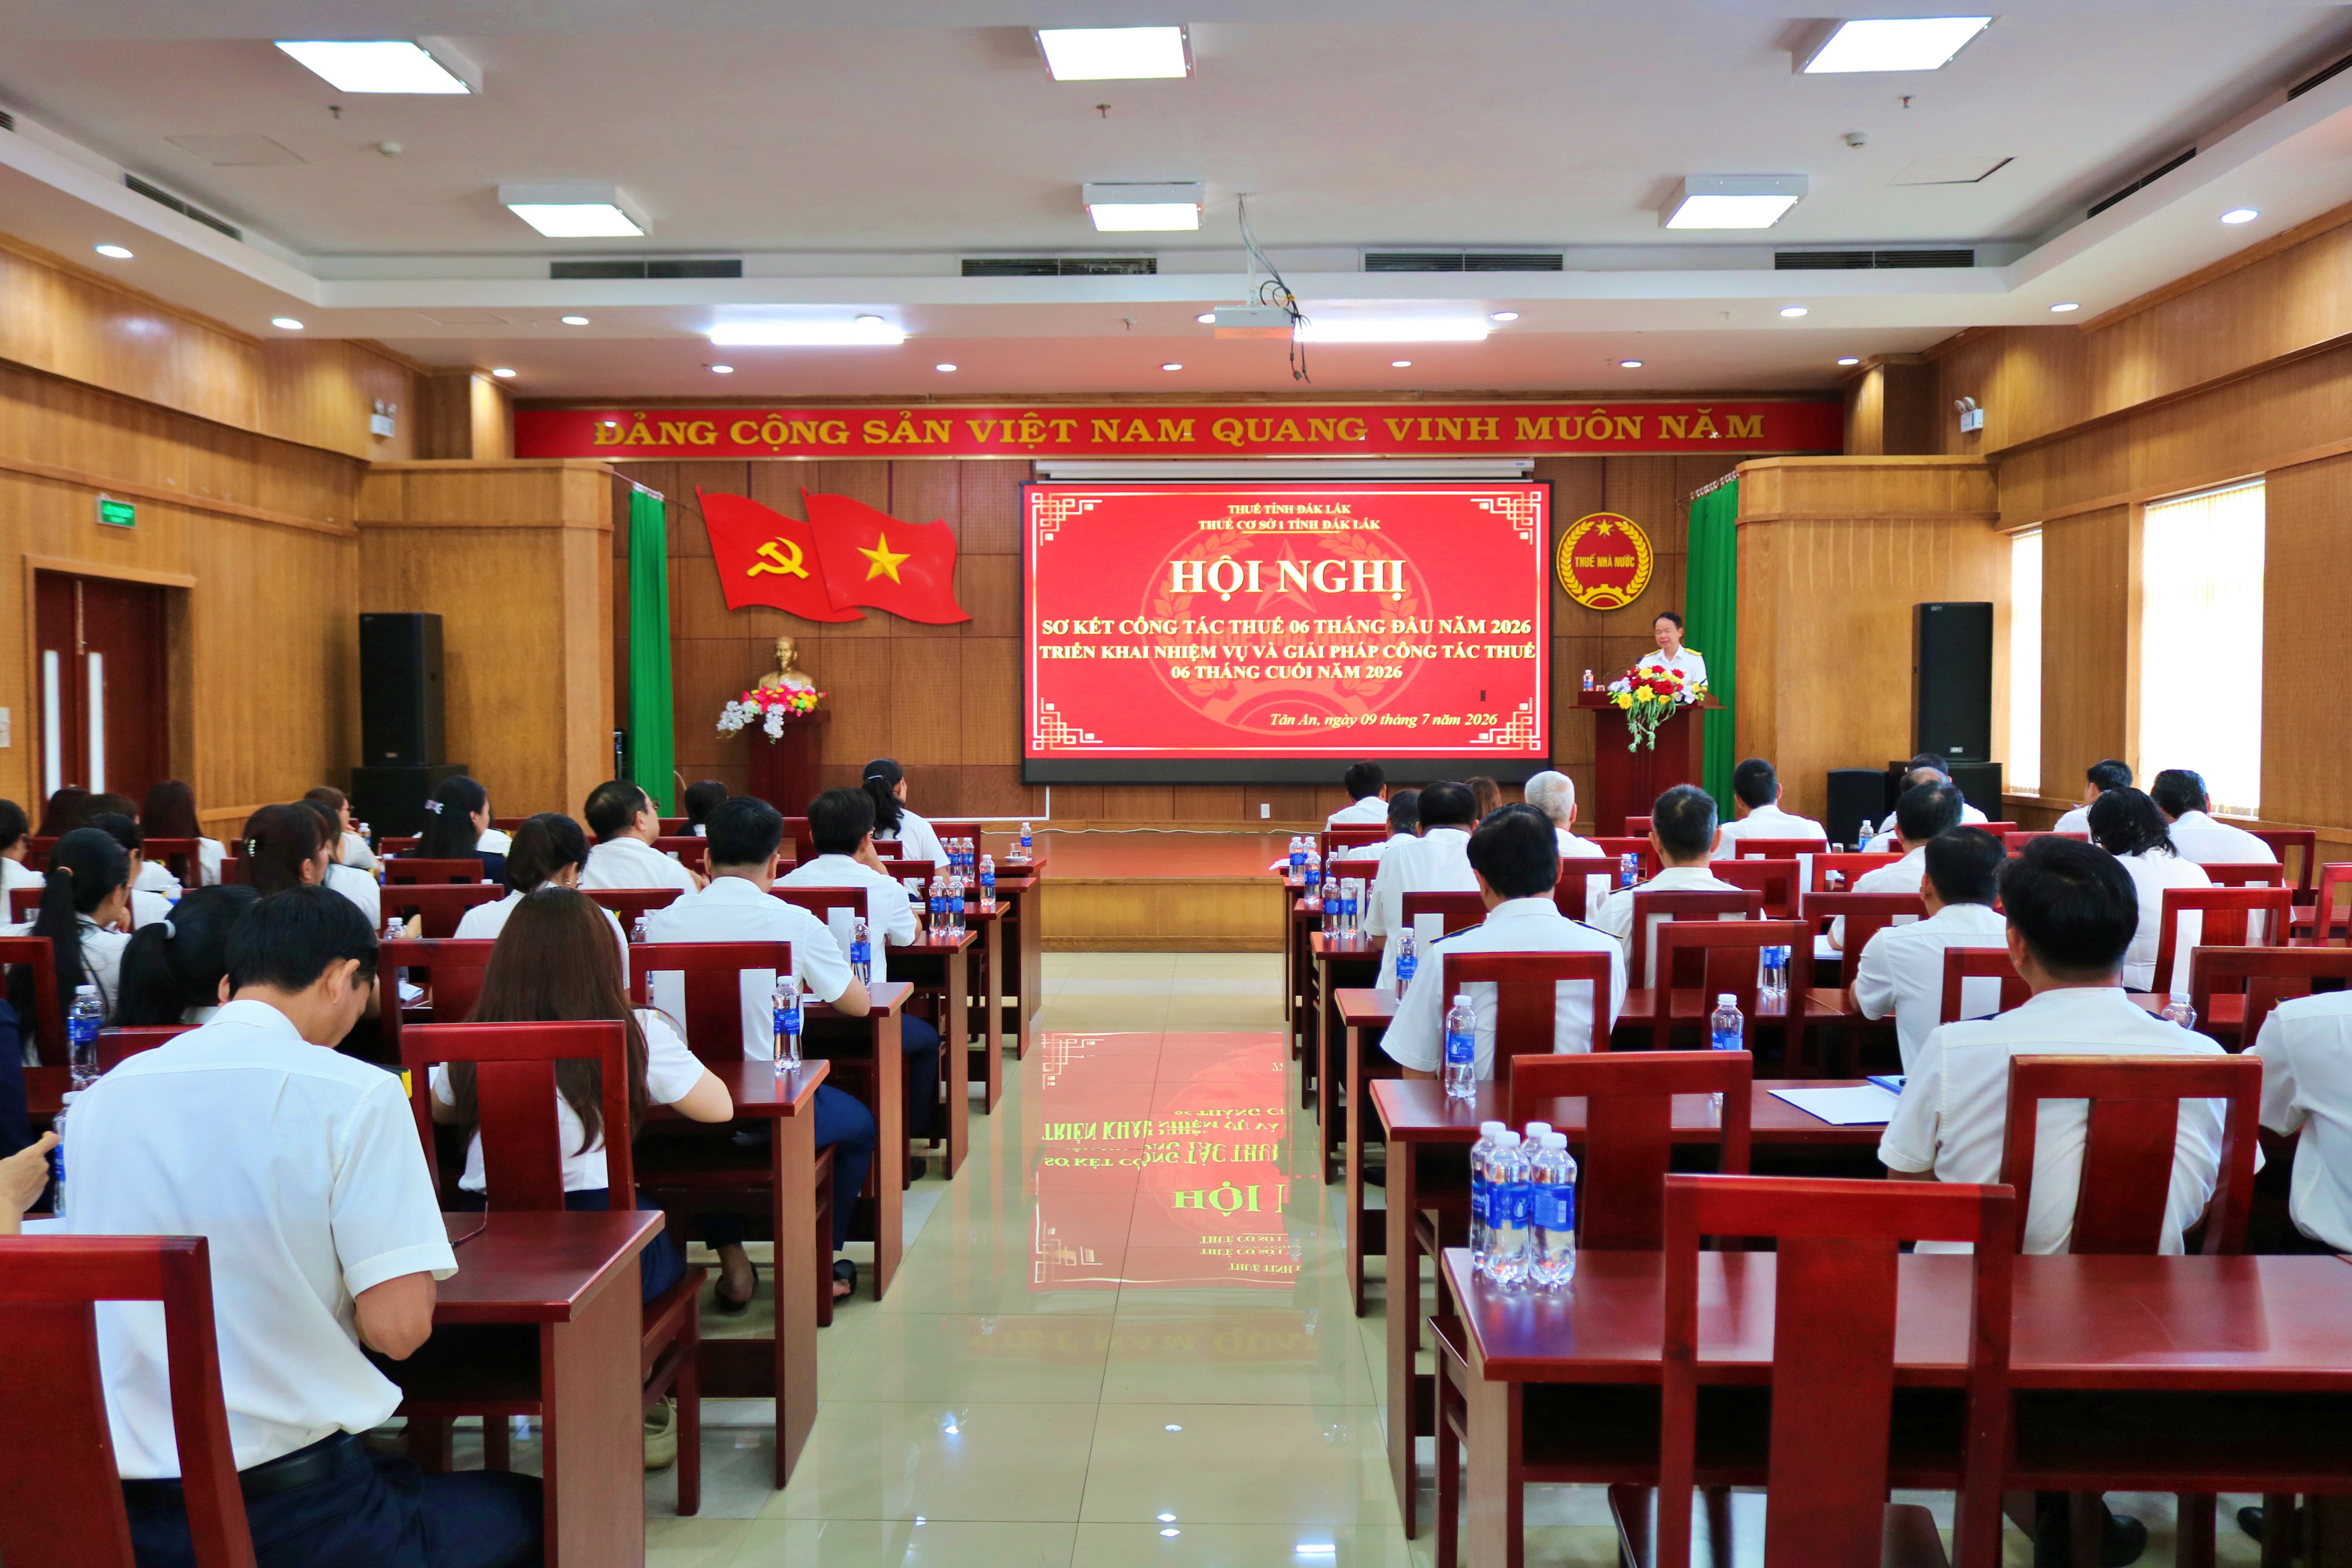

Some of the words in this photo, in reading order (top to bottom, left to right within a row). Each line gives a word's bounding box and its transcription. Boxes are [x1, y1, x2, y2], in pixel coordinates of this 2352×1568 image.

[593, 412, 719, 446] ĐẢNG
[730, 413, 850, 452] CỘNG
[863, 410, 953, 444] SẢN
[965, 411, 1078, 449] VIỆT
[1091, 418, 1196, 443] NAM
[1212, 417, 1368, 447] QUANG
[1383, 417, 1500, 441] VINH
[1515, 408, 1644, 441] MUÔN
[1658, 408, 1765, 439] NĂM
[1263, 502, 1294, 514] TỈNH
[1236, 520, 1257, 530] CƠ
[1259, 518, 1277, 530] SỞ
[1279, 520, 1284, 530] 1
[1287, 518, 1318, 530] TỈNH
[1575, 553, 1595, 568] THUẾ
[1597, 554, 1613, 568] NHÀ
[1614, 554, 1635, 568] NƯỚC
[1169, 555, 1263, 602] HỘI
[1276, 559, 1406, 602] NGHỊ
[1042, 619, 1070, 635] SƠ
[1073, 616, 1114, 635] KẾT
[1119, 615, 1178, 635] CÔNG
[1183, 616, 1224, 635] TÁC
[1229, 616, 1284, 634] THUẾ
[1289, 620, 1310, 634] 06
[1314, 615, 1386, 634] THÁNG
[1391, 616, 1434, 634] ĐẦU
[1439, 615, 1486, 634] NĂM
[1491, 619, 1532, 634] 2026
[1039, 642, 1096, 659] TRIỂN
[1102, 646, 1149, 659] KHAI
[1154, 643, 1217, 662] NHIỆM
[1222, 646, 1248, 662] VỤ
[1253, 641, 1278, 659] VÀ
[1283, 642, 1325, 659] GIẢI
[1330, 641, 1379, 658] PHÁP
[1382, 641, 1437, 659] CÔNG
[1441, 641, 1480, 659] TÁC
[1484, 641, 1536, 659] THUẾ
[1171, 666, 1191, 679] 06
[1194, 662, 1260, 679] THÁNG
[1265, 662, 1312, 679] CUỐI
[1318, 662, 1361, 679] NĂM
[1365, 665, 1403, 679] 2026
[1270, 713, 1295, 725] Tân
[1298, 713, 1320, 726] An,
[1324, 713, 1357, 728] ngày
[1361, 713, 1377, 725] 09
[1380, 713, 1418, 728] tháng
[1422, 713, 1430, 725] 7
[1432, 714, 1461, 725] năm
[1465, 713, 1498, 726] 2026
